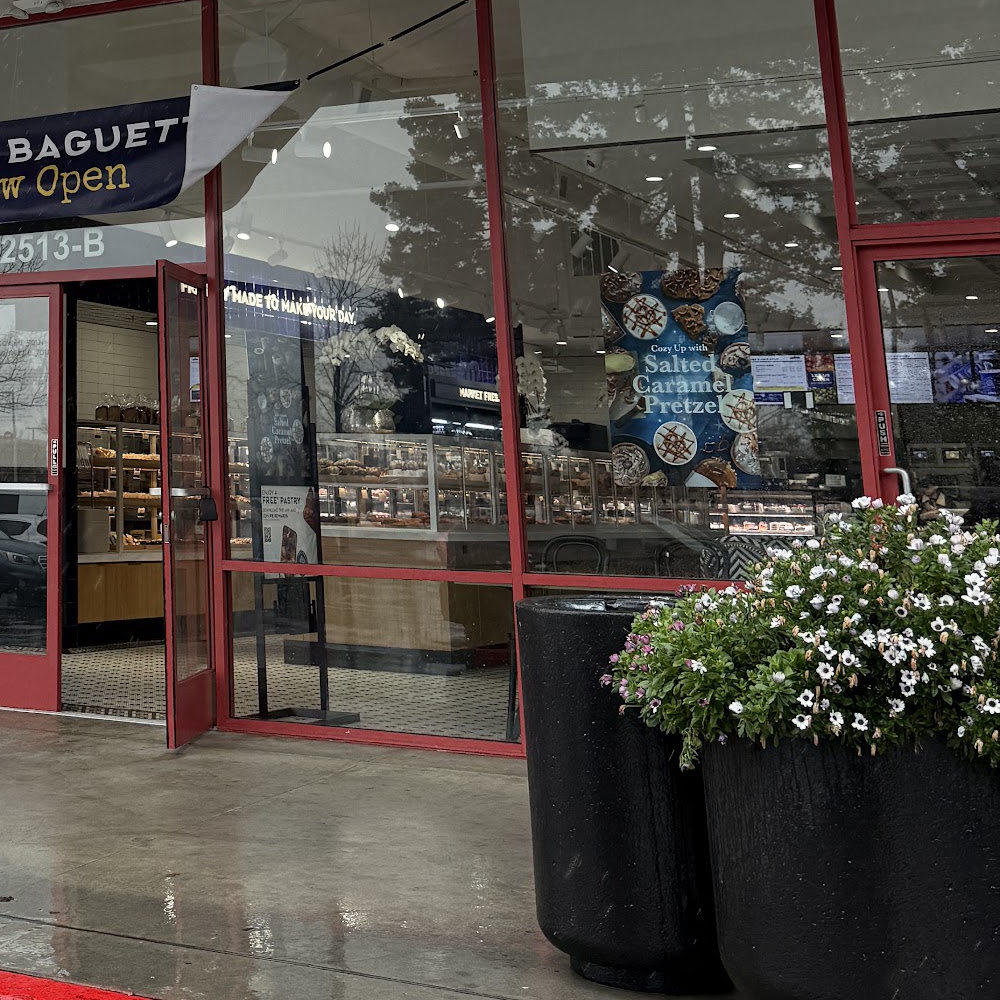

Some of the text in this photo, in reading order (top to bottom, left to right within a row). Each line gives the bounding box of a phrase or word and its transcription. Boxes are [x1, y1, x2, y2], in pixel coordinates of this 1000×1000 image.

[37, 163, 130, 204] Open
[0, 228, 105, 264] 2513-B
[232, 289, 263, 308] MADE
[264, 294, 279, 311] TO
[281, 298, 310, 316] MAKE
[311, 303, 336, 321] YOUR
[651, 344, 672, 352] Cozy
[674, 344, 686, 352] Up
[645, 354, 717, 373] Salted
[633, 374, 733, 393] Caramel
[643, 395, 725, 414] Pretzel
[877, 416, 888, 443] PUSH
[280, 496, 300, 505] PASTRY
